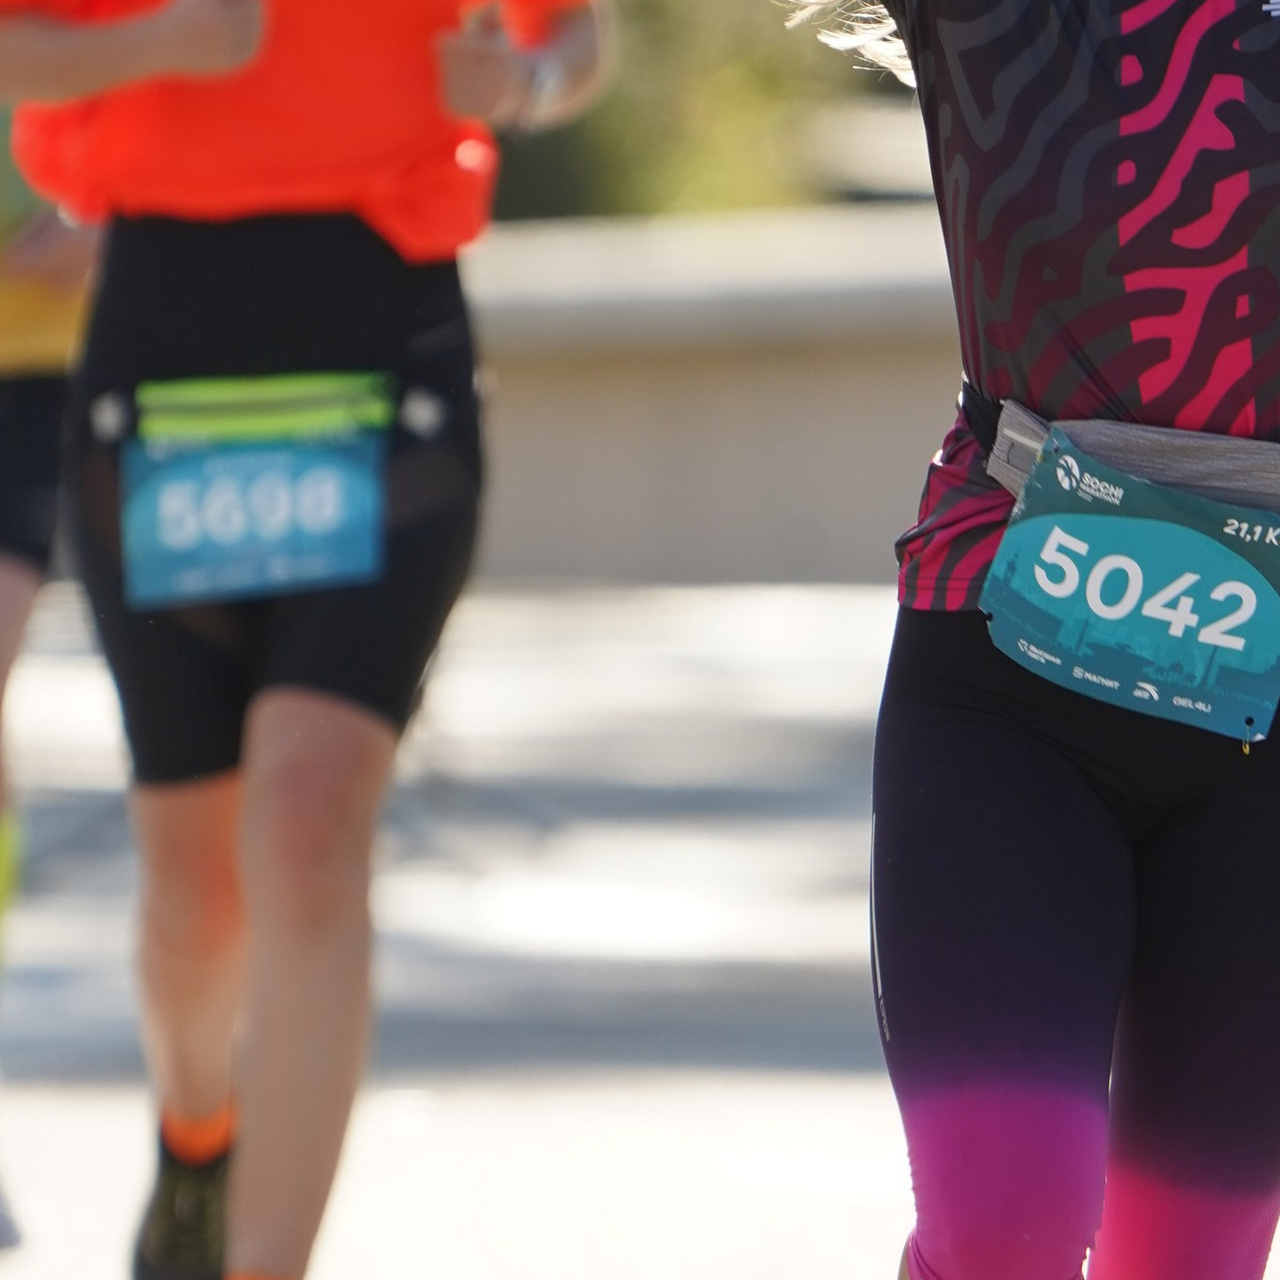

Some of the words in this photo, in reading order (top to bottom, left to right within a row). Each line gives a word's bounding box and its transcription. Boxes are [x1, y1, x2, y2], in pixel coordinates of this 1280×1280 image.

[1082, 472, 1124, 500] SOCHI
[1223, 518, 1262, 543] 21,1
[1034, 525, 1257, 651] 5042
